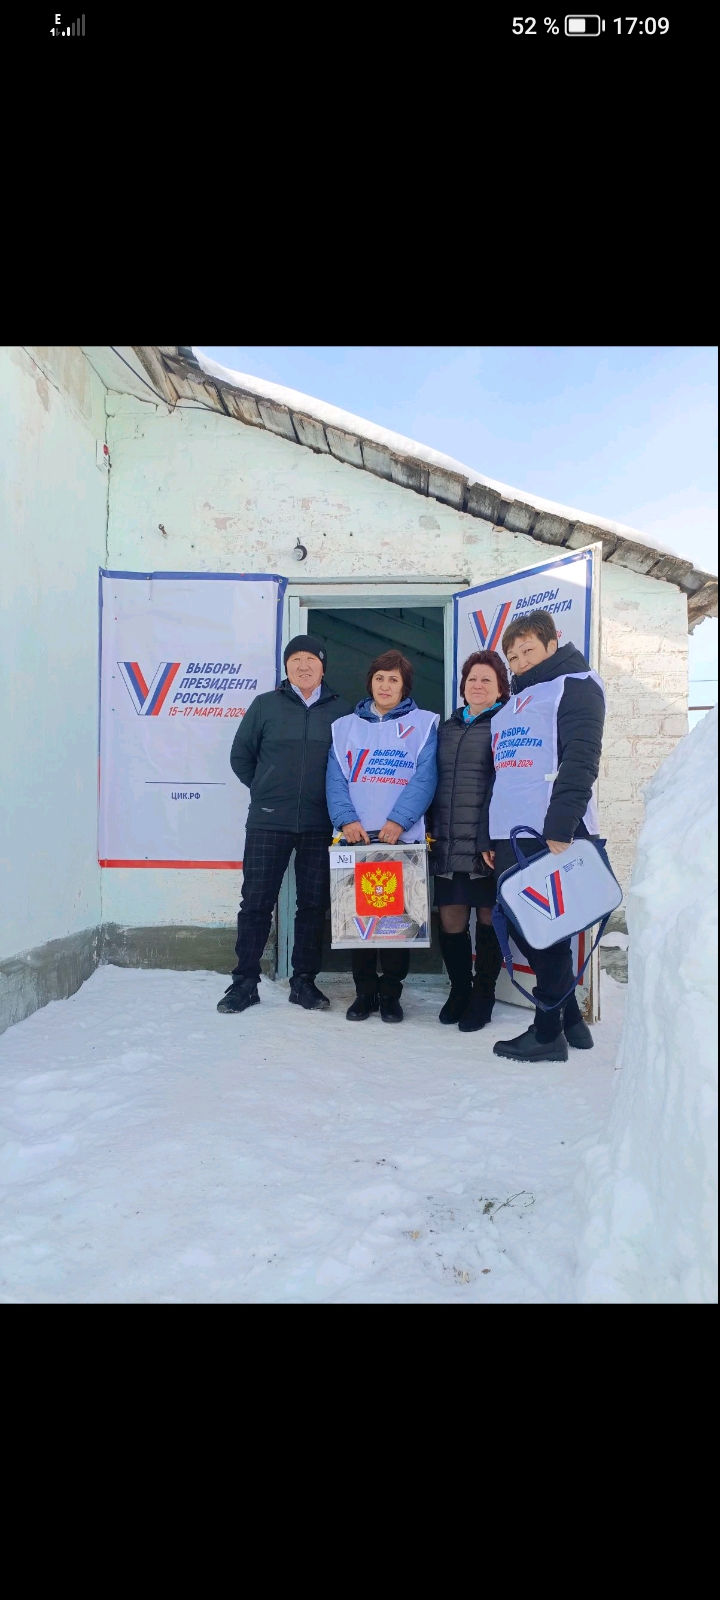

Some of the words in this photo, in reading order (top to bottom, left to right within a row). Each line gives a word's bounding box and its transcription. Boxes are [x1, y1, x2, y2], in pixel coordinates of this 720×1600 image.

[515, 588, 560, 610] ВЫБОРЫ
[511, 599, 573, 622] ПРЕЕНТА
[185, 662, 242, 675] ВЫБОРЫ
[178, 678, 258, 691] ПРЕЗИДЕНТА
[172, 692, 224, 704] РОССИИ
[168, 706, 192, 717] 15–17
[193, 707, 223, 718] МАРТА
[224, 707, 246, 718] 2024
[496, 737, 543, 750] РЕЗИДЕНТА
[373, 749, 408, 758] ВЫБОРЫ
[368, 758, 415, 769] ПРЕЗИДЕНТА
[517, 759, 533, 768] 2024
[364, 767, 396, 776] РОССИИ
[376, 776, 396, 784] МАРТА
[171, 791, 201, 801] ЦИК.РФ
[337, 854, 353, 864] №1
